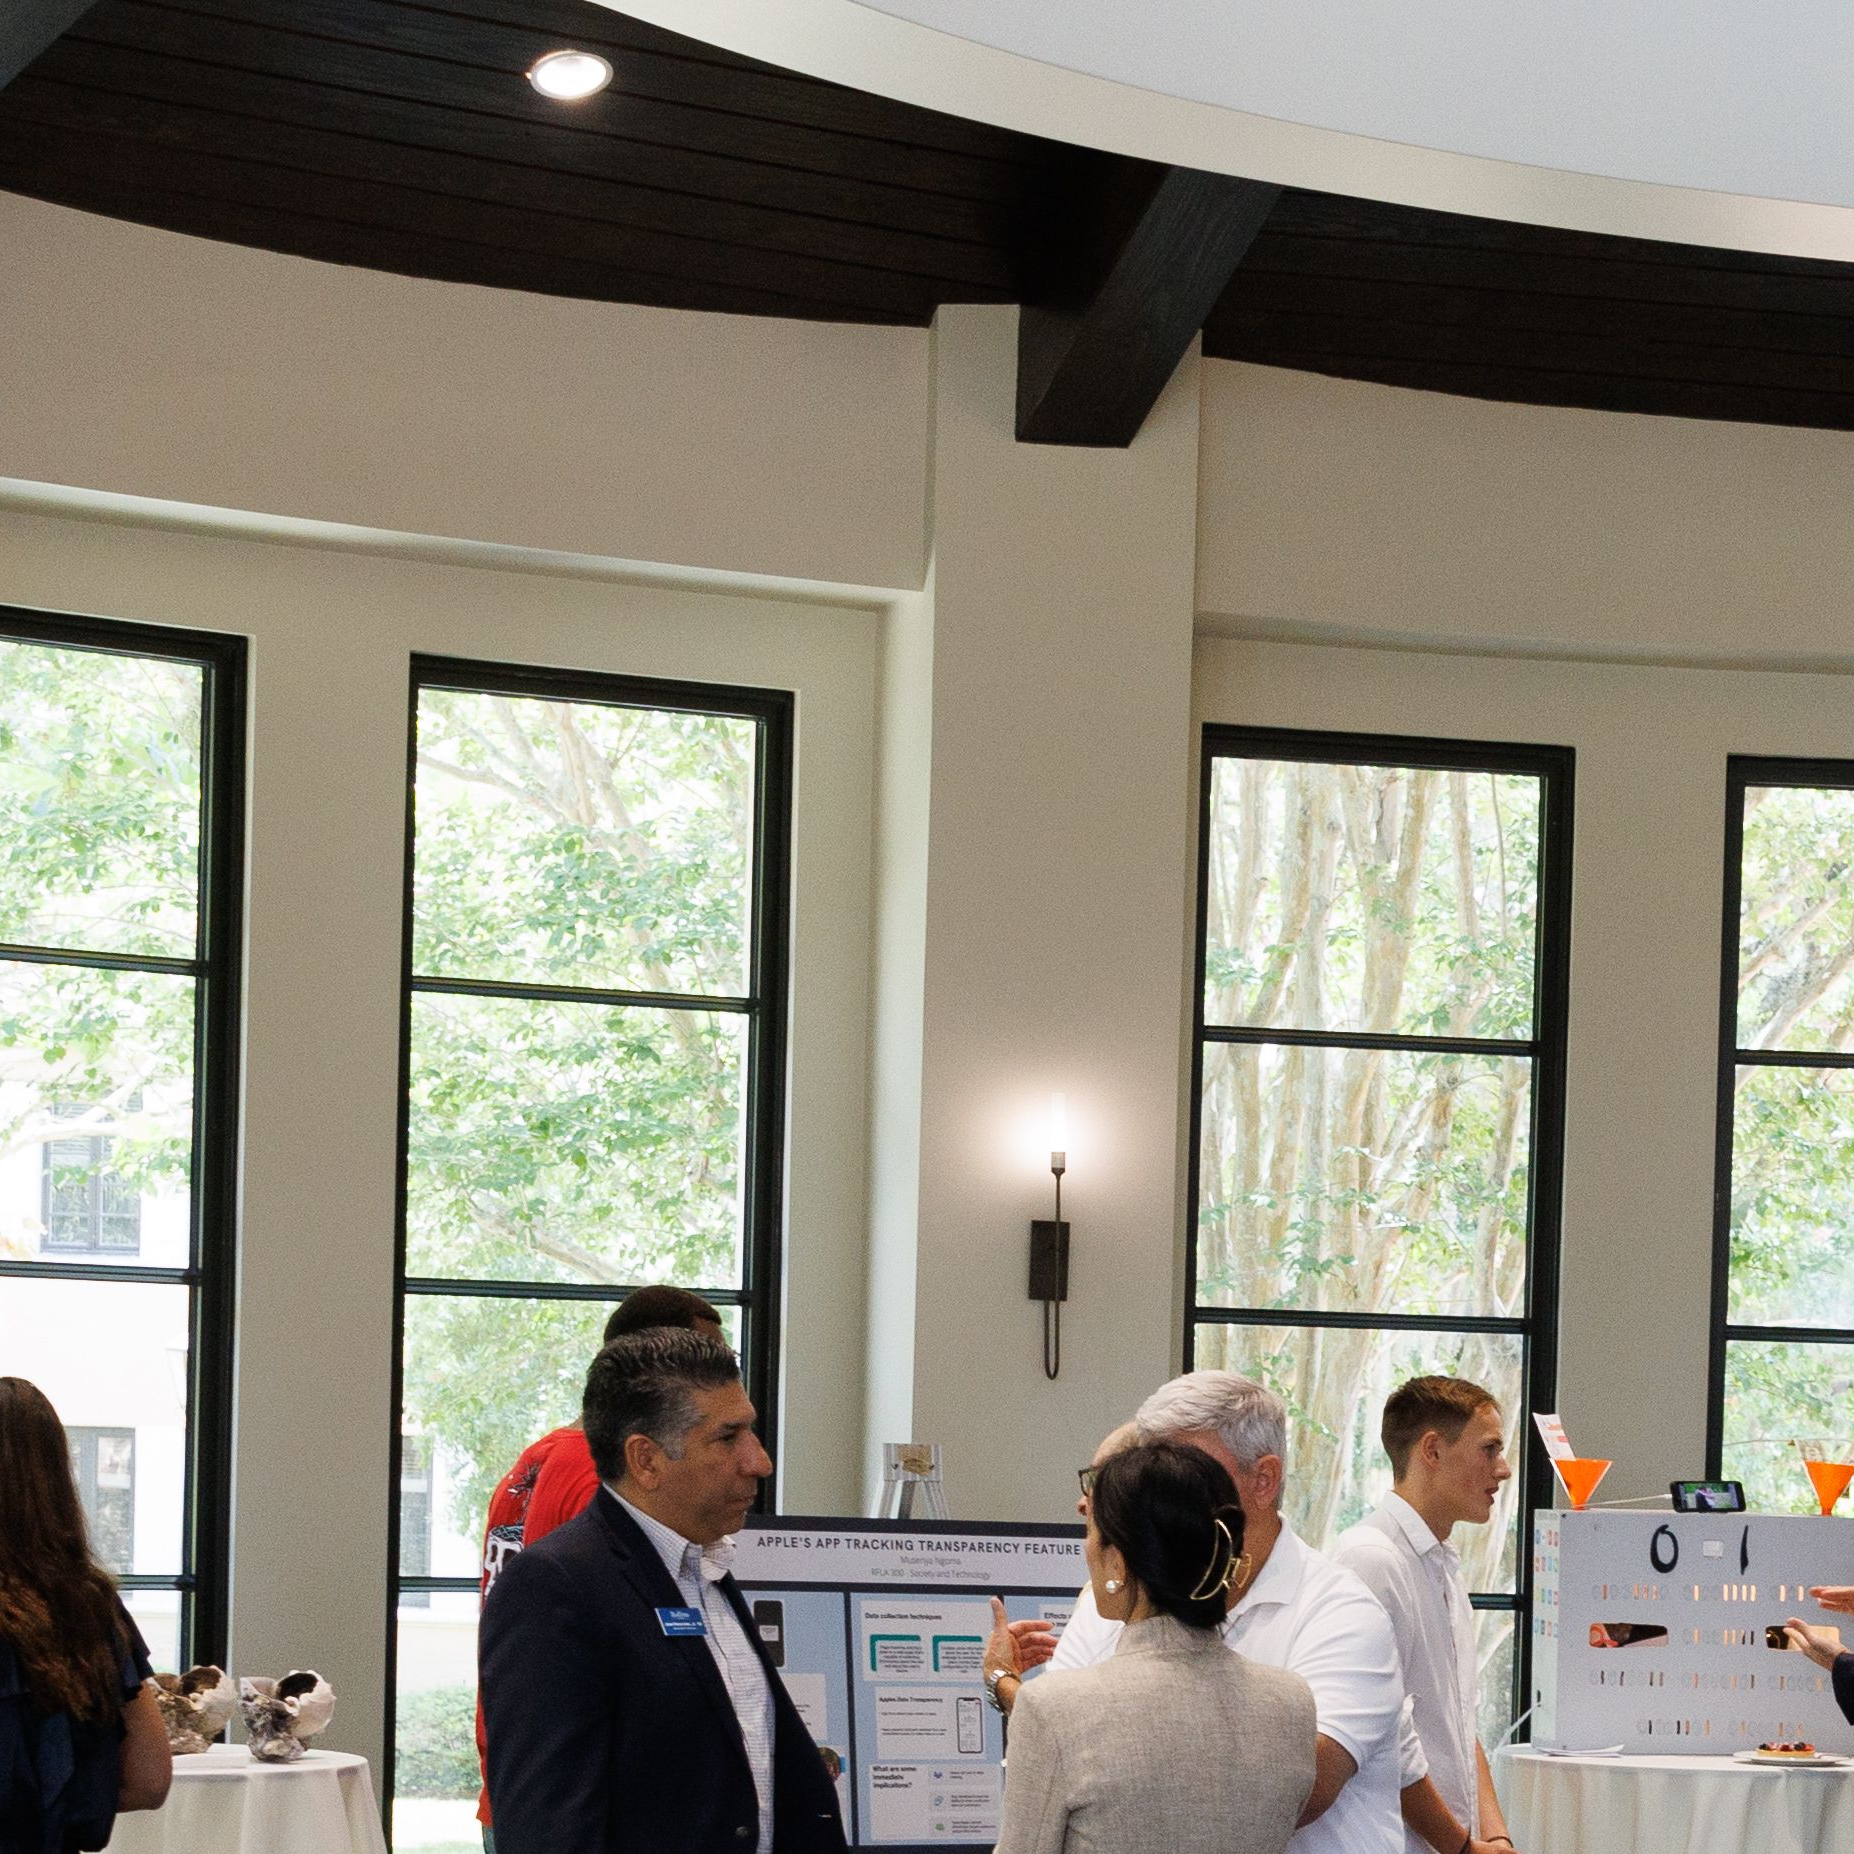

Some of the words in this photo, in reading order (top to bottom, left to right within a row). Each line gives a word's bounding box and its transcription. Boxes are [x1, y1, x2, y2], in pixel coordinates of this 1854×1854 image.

[757, 1536, 811, 1548] APPLE'S
[816, 1538, 840, 1549] APP
[846, 1538, 914, 1550] TRACKING
[918, 1540, 1020, 1554] TRANSPARENCY
[1025, 1543, 1080, 1555] FEATURE
[952, 1570, 990, 1580] Technology
